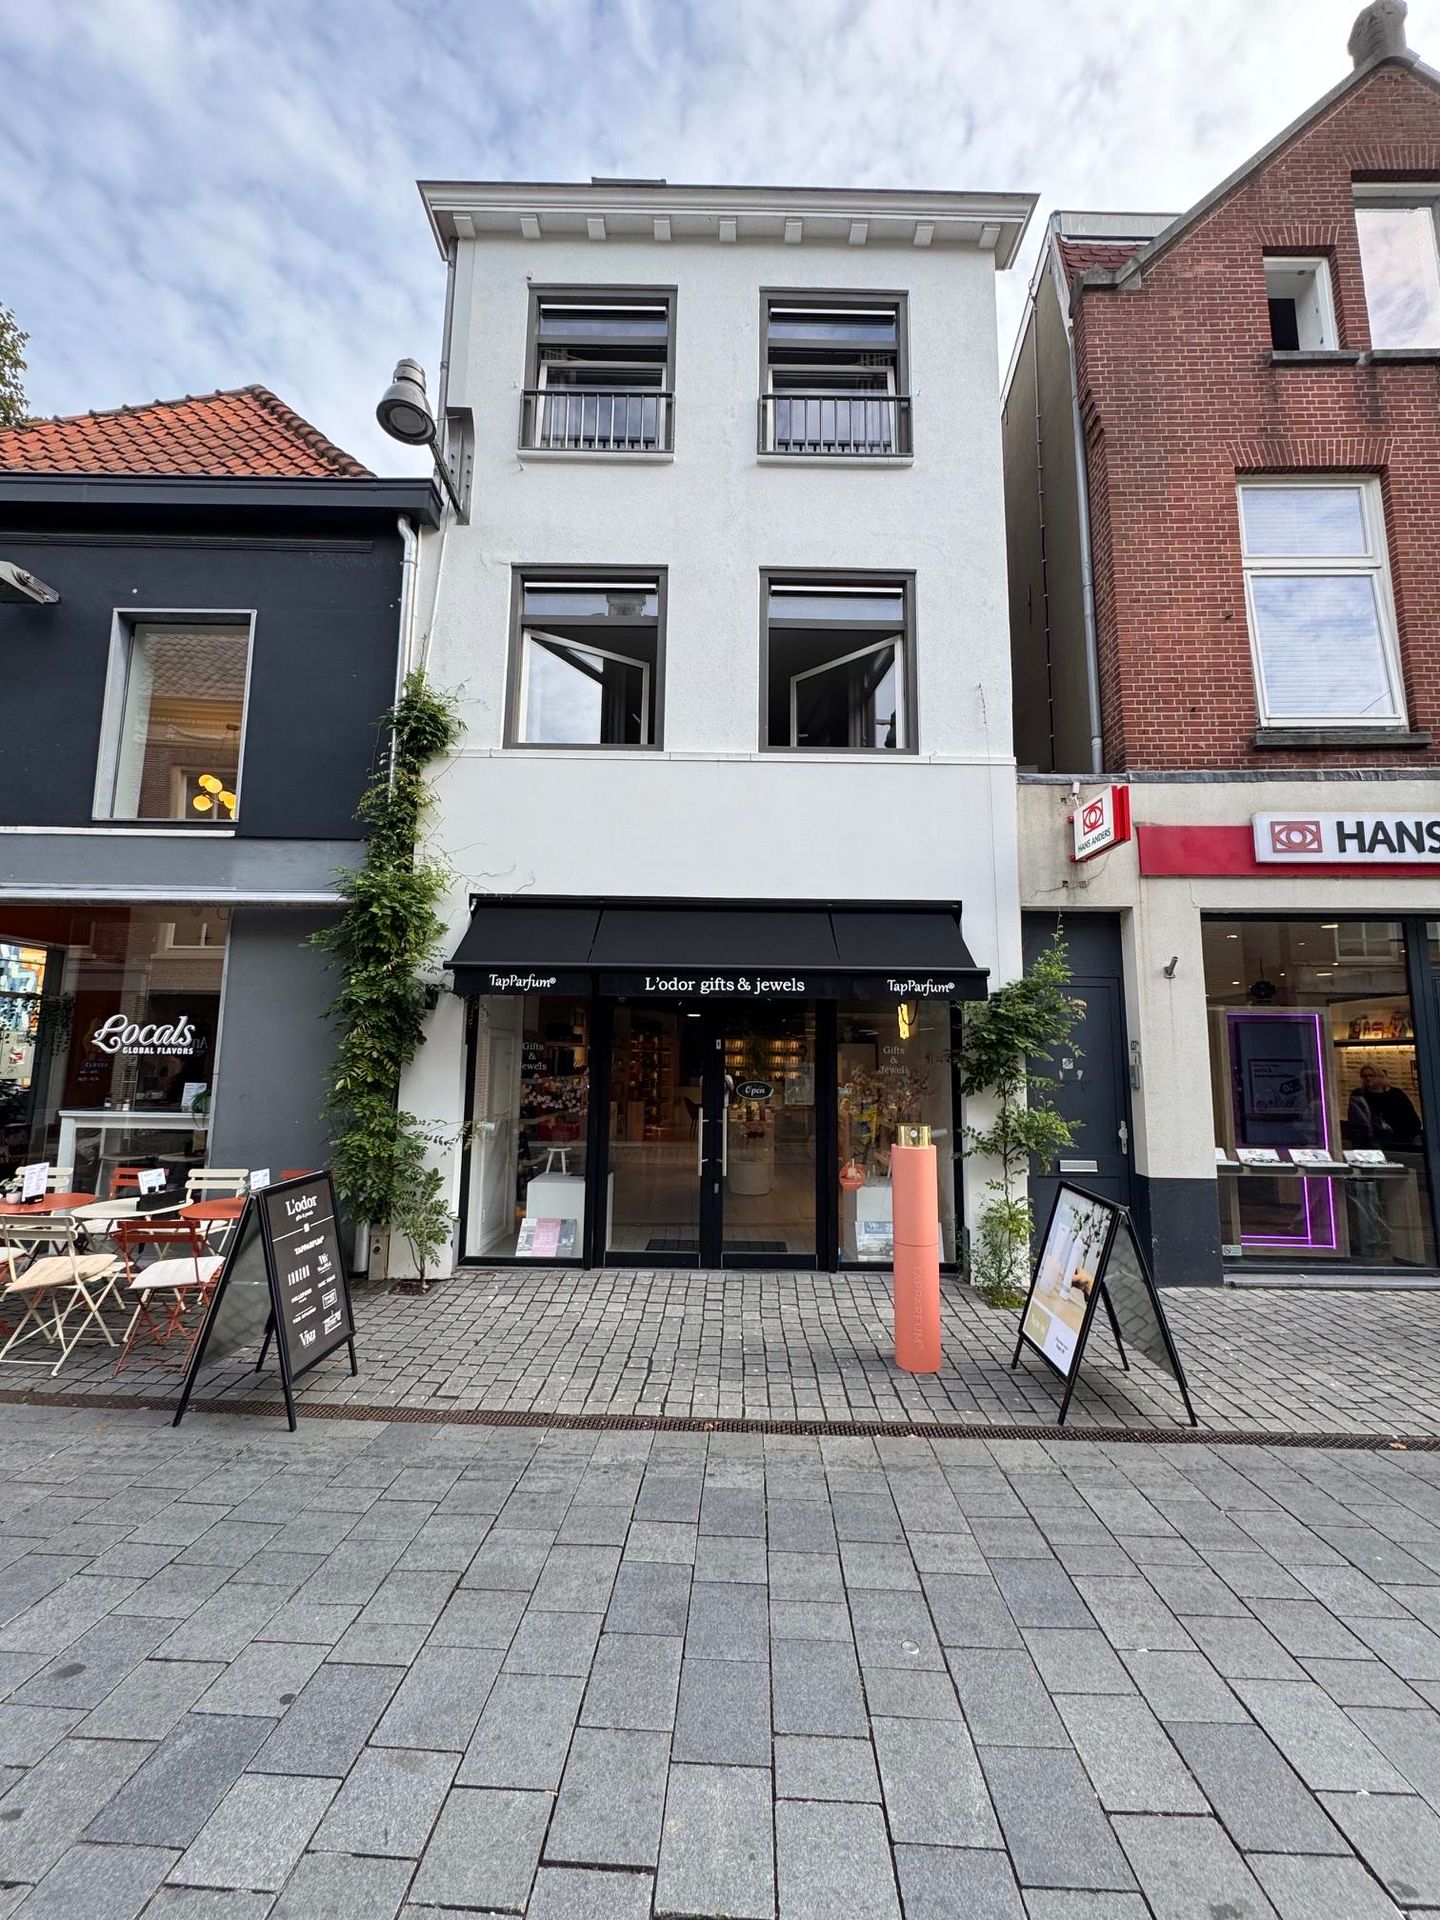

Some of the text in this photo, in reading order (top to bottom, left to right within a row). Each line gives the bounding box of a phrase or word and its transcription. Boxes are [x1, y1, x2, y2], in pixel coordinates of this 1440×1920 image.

[1077, 828, 1112, 853] HANS ANDERS
[1336, 820, 1440, 854] HANS
[700, 977, 735, 995] gifts
[737, 977, 752, 991] &
[753, 977, 805, 995] jewels
[90, 1013, 196, 1054] Locals
[122, 1046, 194, 1055] GLOBAL FLAVORS
[522, 1041, 545, 1051] Gifts
[883, 1045, 905, 1055] Gifts
[528, 1052, 537, 1060] &
[890, 1055, 899, 1064] &
[744, 1085, 766, 1097] Open
[284, 1195, 318, 1217] L'odor
